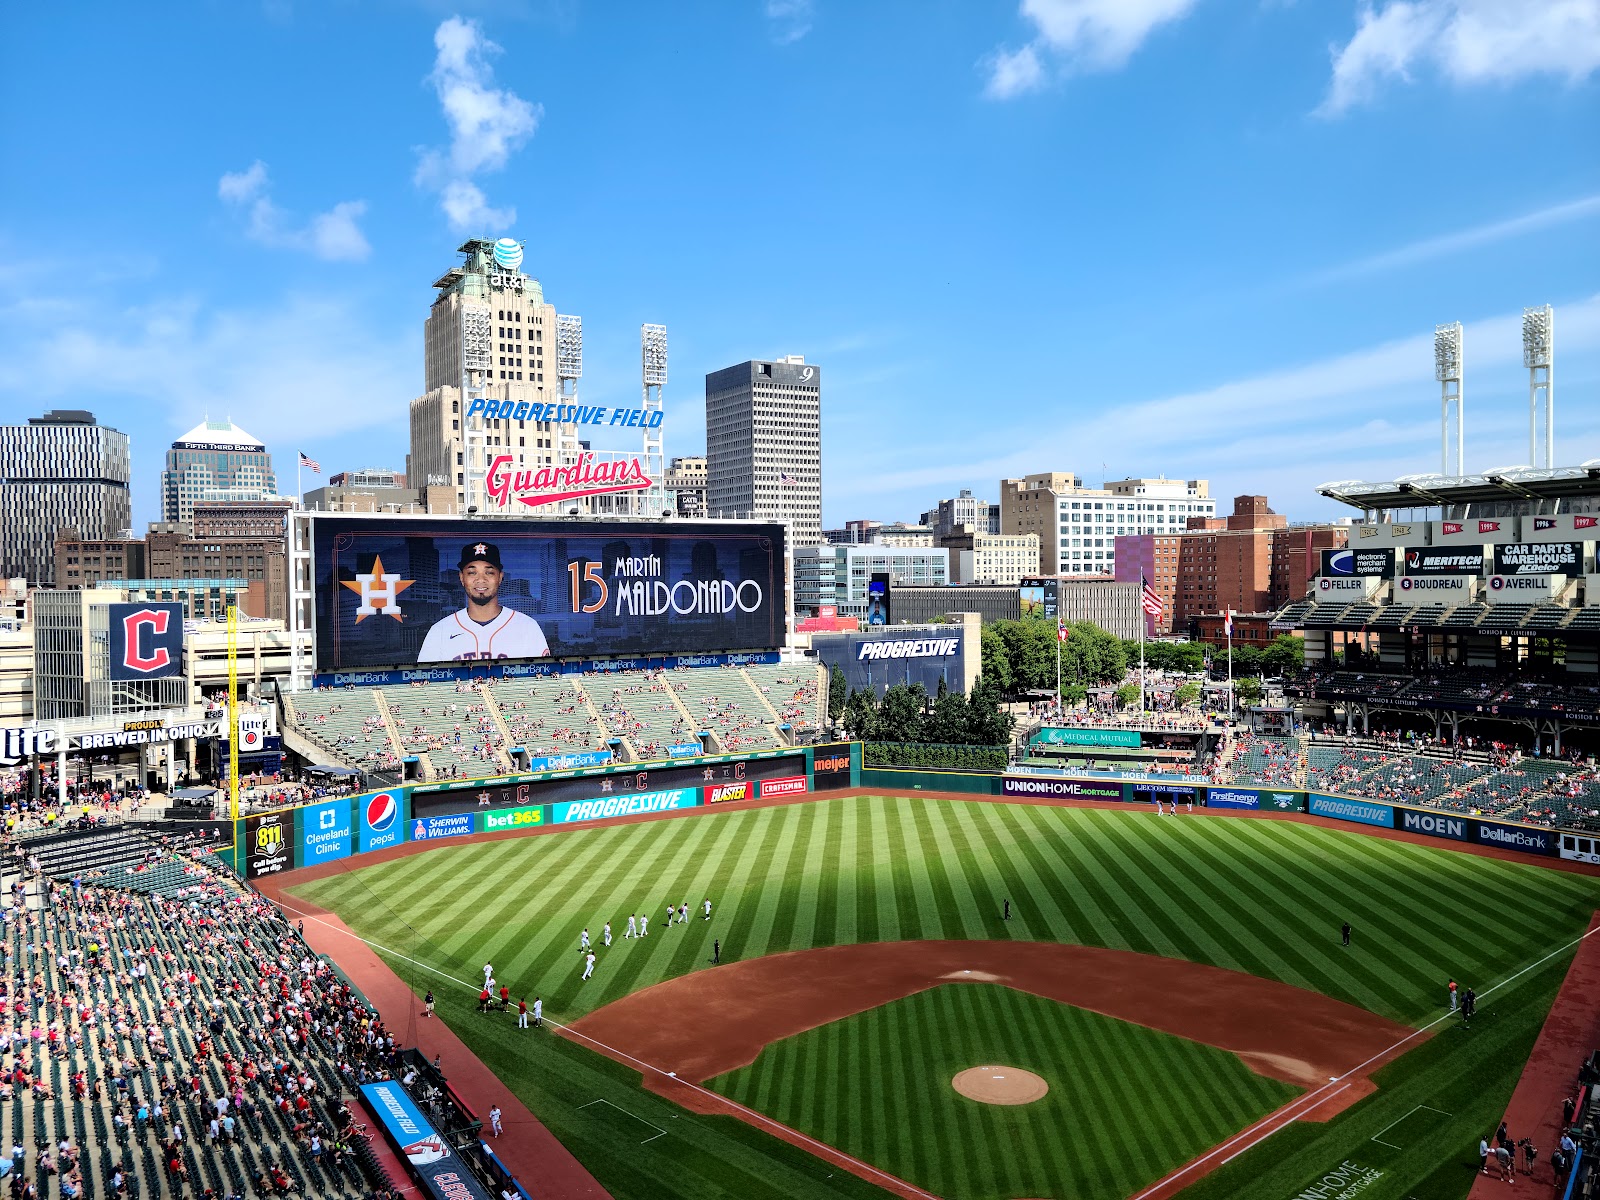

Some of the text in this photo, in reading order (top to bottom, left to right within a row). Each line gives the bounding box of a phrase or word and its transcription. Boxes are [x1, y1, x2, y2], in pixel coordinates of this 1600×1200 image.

[491, 269, 526, 288] at&t
[799, 367, 813, 382] 9
[467, 398, 664, 428] PROGRESSIVE FIELD
[486, 453, 654, 508] Guardians
[1536, 520, 1549, 528] 1996
[1505, 545, 1571, 555] CAR PARTS
[615, 554, 661, 577] MARTÍN
[1423, 556, 1482, 566] MERITECH
[1502, 554, 1576, 565] WAREHOUSE
[568, 561, 608, 613] 15
[1332, 580, 1362, 590] FELLER
[1414, 579, 1463, 590] BOUDREAU
[1494, 579, 1548, 590] 3 AVERILL
[615, 579, 763, 617] MALDONADO
[123, 609, 171, 672] C
[858, 638, 960, 661] PROGRESSIVE
[592, 659, 637, 669] DollarBank
[678, 656, 719, 665] DollarBank
[727, 653, 767, 663] DollarBank
[402, 670, 454, 681] DollarBank
[503, 664, 550, 675] DollarBank
[335, 674, 390, 684] DollarBank
[125, 720, 165, 731] PROUDLY
[242, 720, 261, 731] Lite
[82, 725, 203, 749] BREWED IN OHIO
[1064, 732, 1132, 742] MEDICAL MUTUAL
[814, 755, 850, 773] meijer
[735, 762, 745, 779] C
[1063, 769, 1089, 777] MOEN
[1121, 772, 1148, 781] MOEN
[636, 772, 648, 790] C
[1182, 775, 1209, 783] MOEN
[765, 782, 804, 793] CRAFTSMAN
[1081, 788, 1120, 796] MORTGAGE
[1136, 784, 1167, 792] LECOM
[502, 793, 511, 801] VS
[517, 785, 530, 803] C
[710, 785, 747, 803] BLASTER
[1210, 791, 1257, 803] FirstEnergy
[563, 790, 682, 822] PROGRESSIVE
[1312, 799, 1388, 822] PROGRESSIVE
[429, 816, 469, 831] SHERWIN
[487, 810, 542, 828] bet365
[1404, 813, 1462, 836] MOEN
[258, 825, 281, 847] 811
[306, 826, 350, 845] Cleveland
[370, 831, 396, 848] pepsi
[1480, 825, 1546, 849] DollarBank
[315, 842, 341, 855] Clinic
[253, 856, 287, 868] Call before
[257, 864, 283, 875] you dig.
